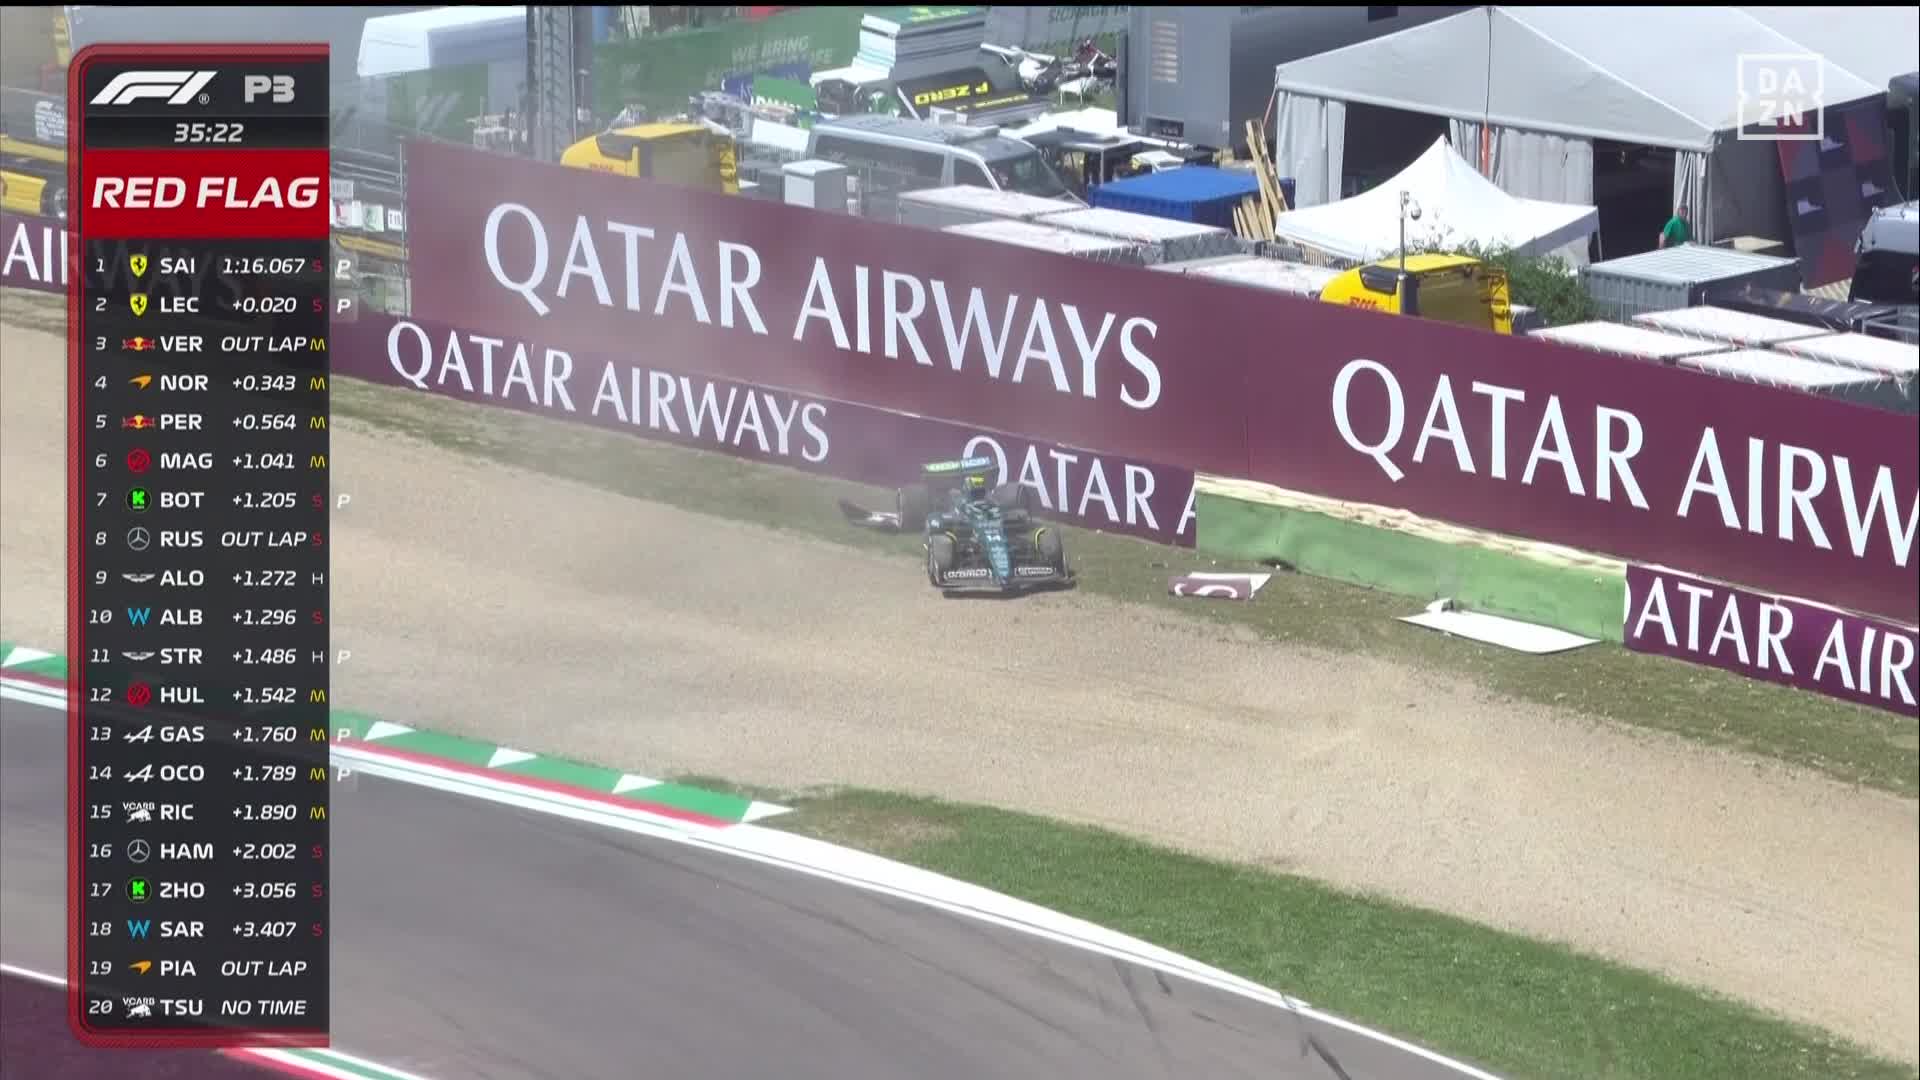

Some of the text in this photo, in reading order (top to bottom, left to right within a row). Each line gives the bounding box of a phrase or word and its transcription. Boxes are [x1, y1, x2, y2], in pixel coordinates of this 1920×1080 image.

[484, 203, 1161, 410] QATAR AIRWAYS
[387, 321, 829, 463] QATAR AIRWAYS
[1332, 359, 1650, 510] QATAR
[1624, 575, 1918, 706] ATAR AIR
